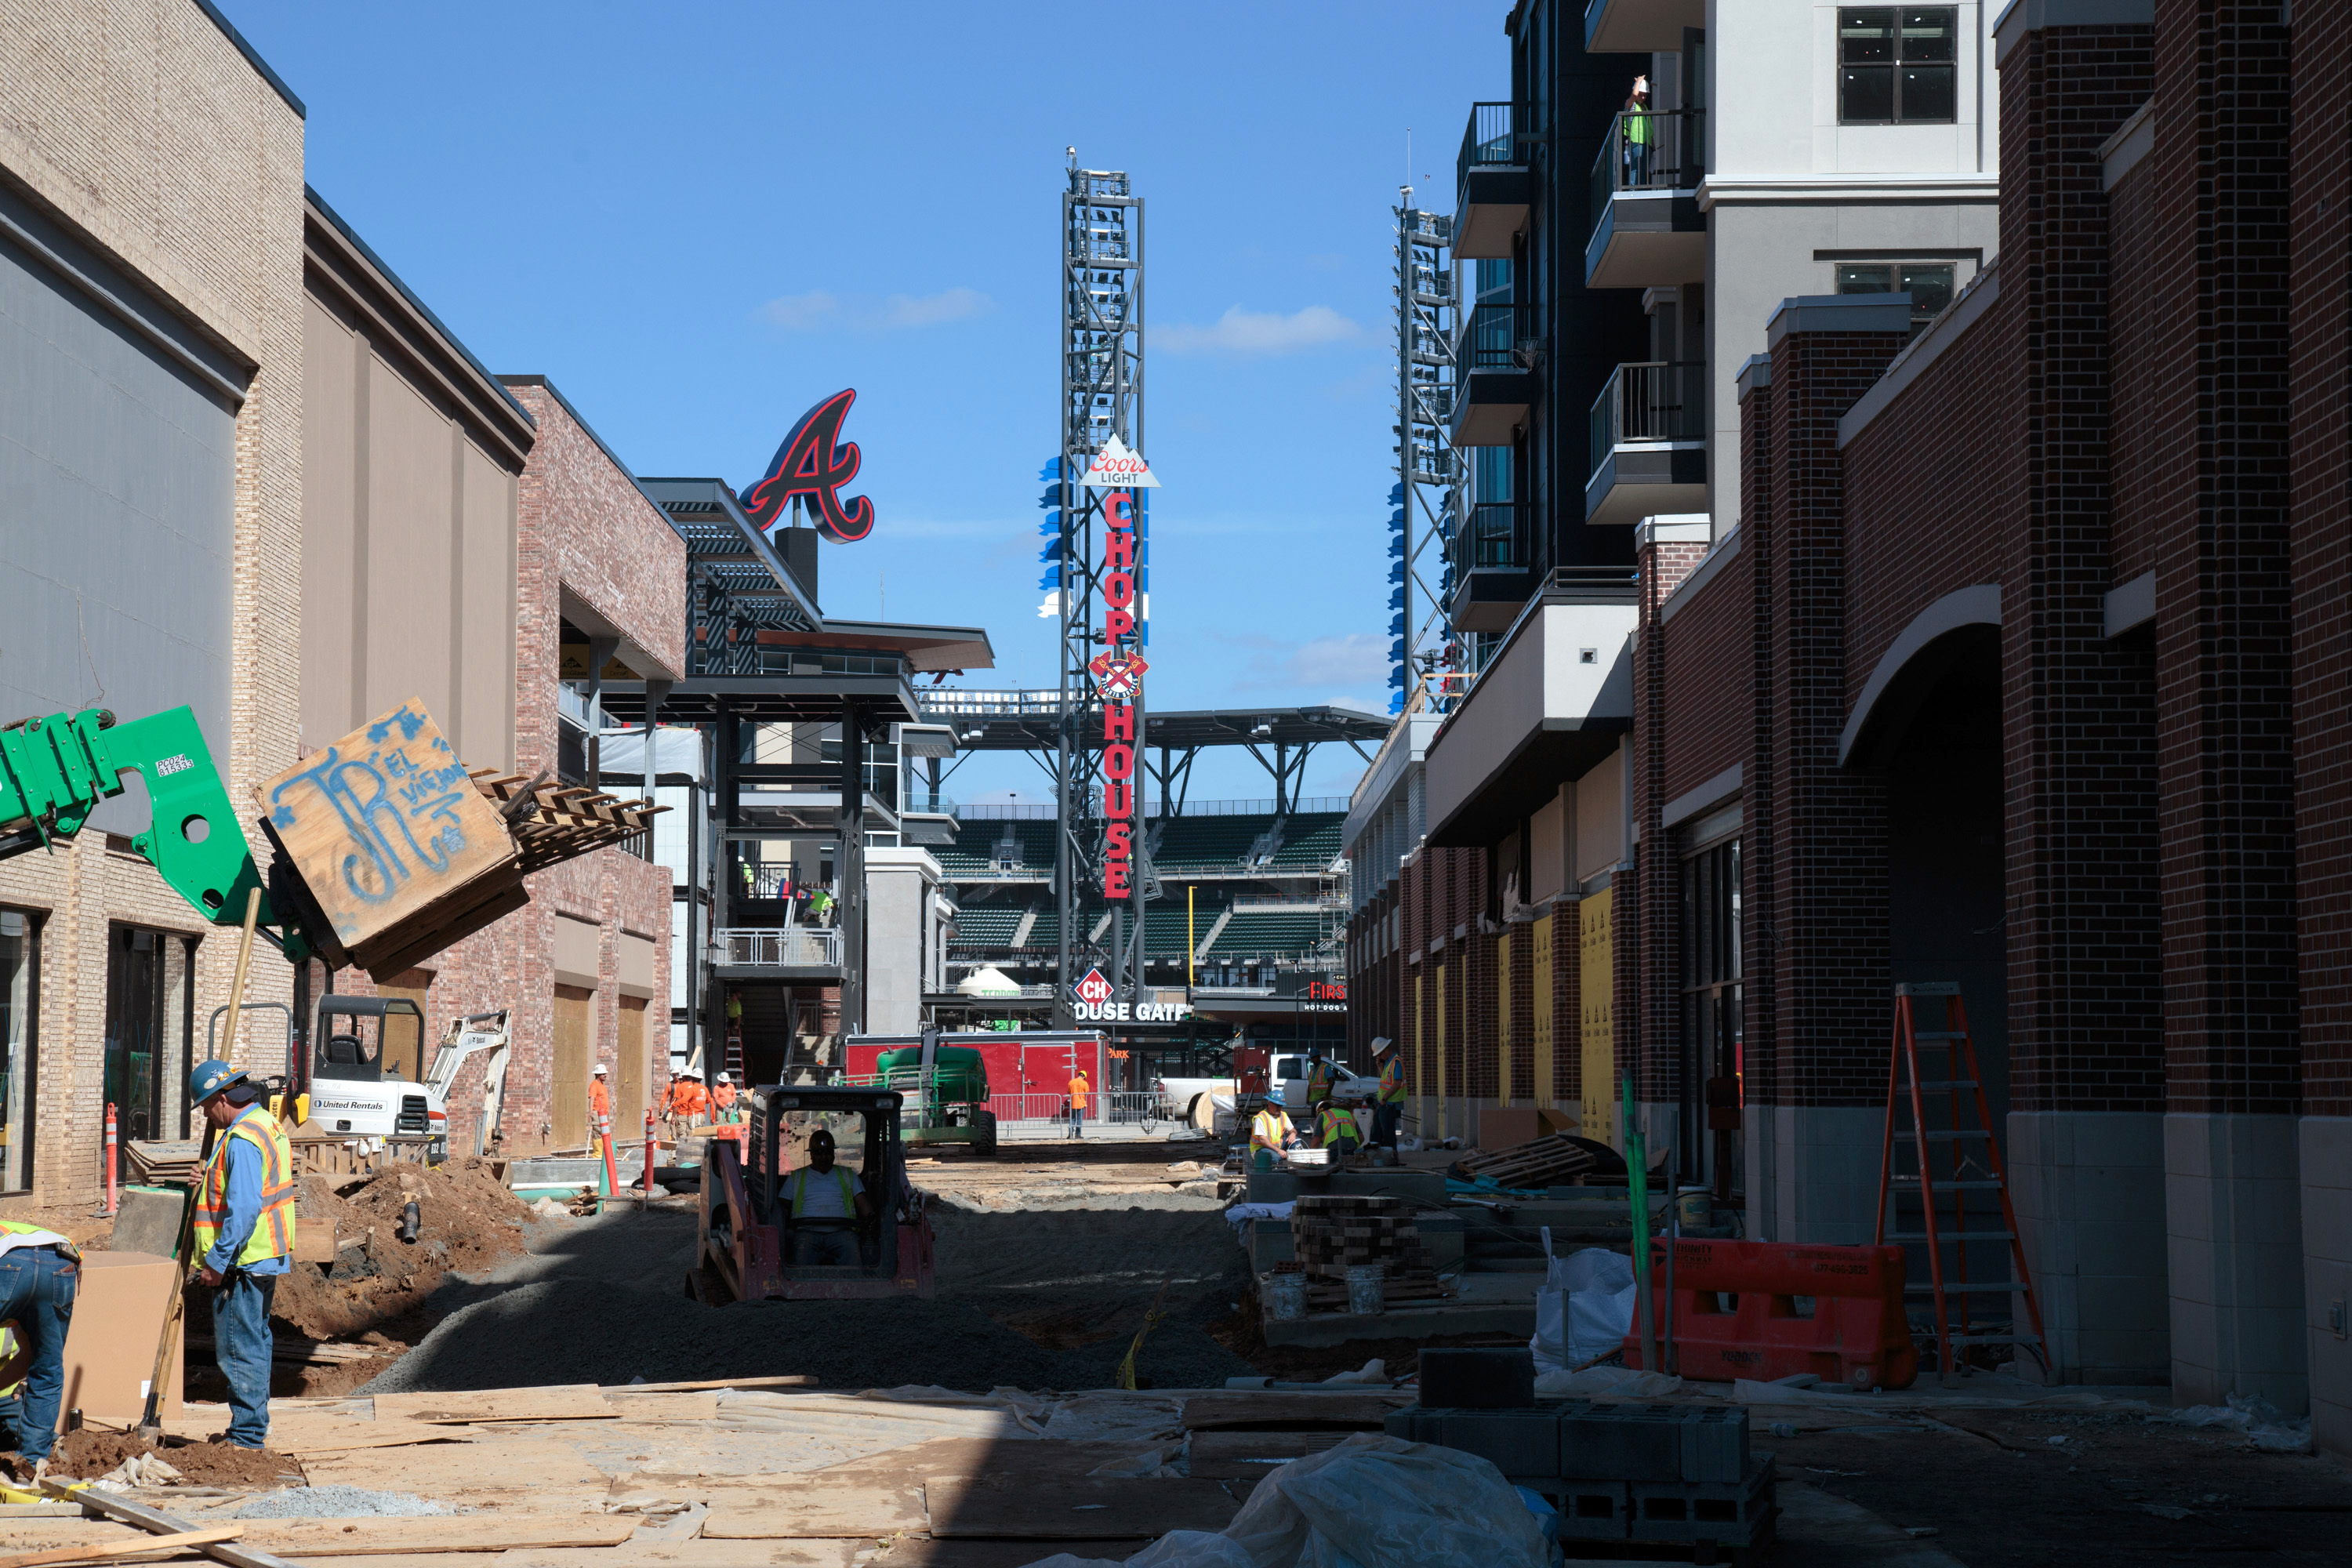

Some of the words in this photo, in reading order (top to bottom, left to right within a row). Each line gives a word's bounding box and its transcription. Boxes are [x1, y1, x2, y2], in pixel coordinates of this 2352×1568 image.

[1091, 450, 1149, 473] Coors
[1101, 472, 1138, 484] LIGHT
[1105, 492, 1134, 646] CHOP
[159, 760, 194, 777] 815333
[383, 748, 419, 778] EL
[1104, 705, 1134, 898] HOUSE
[1083, 981, 1105, 999] CH
[1310, 982, 1348, 1000] FIRS
[1069, 1002, 1130, 1021] OUSE
[350, 1101, 383, 1110] Rentals
